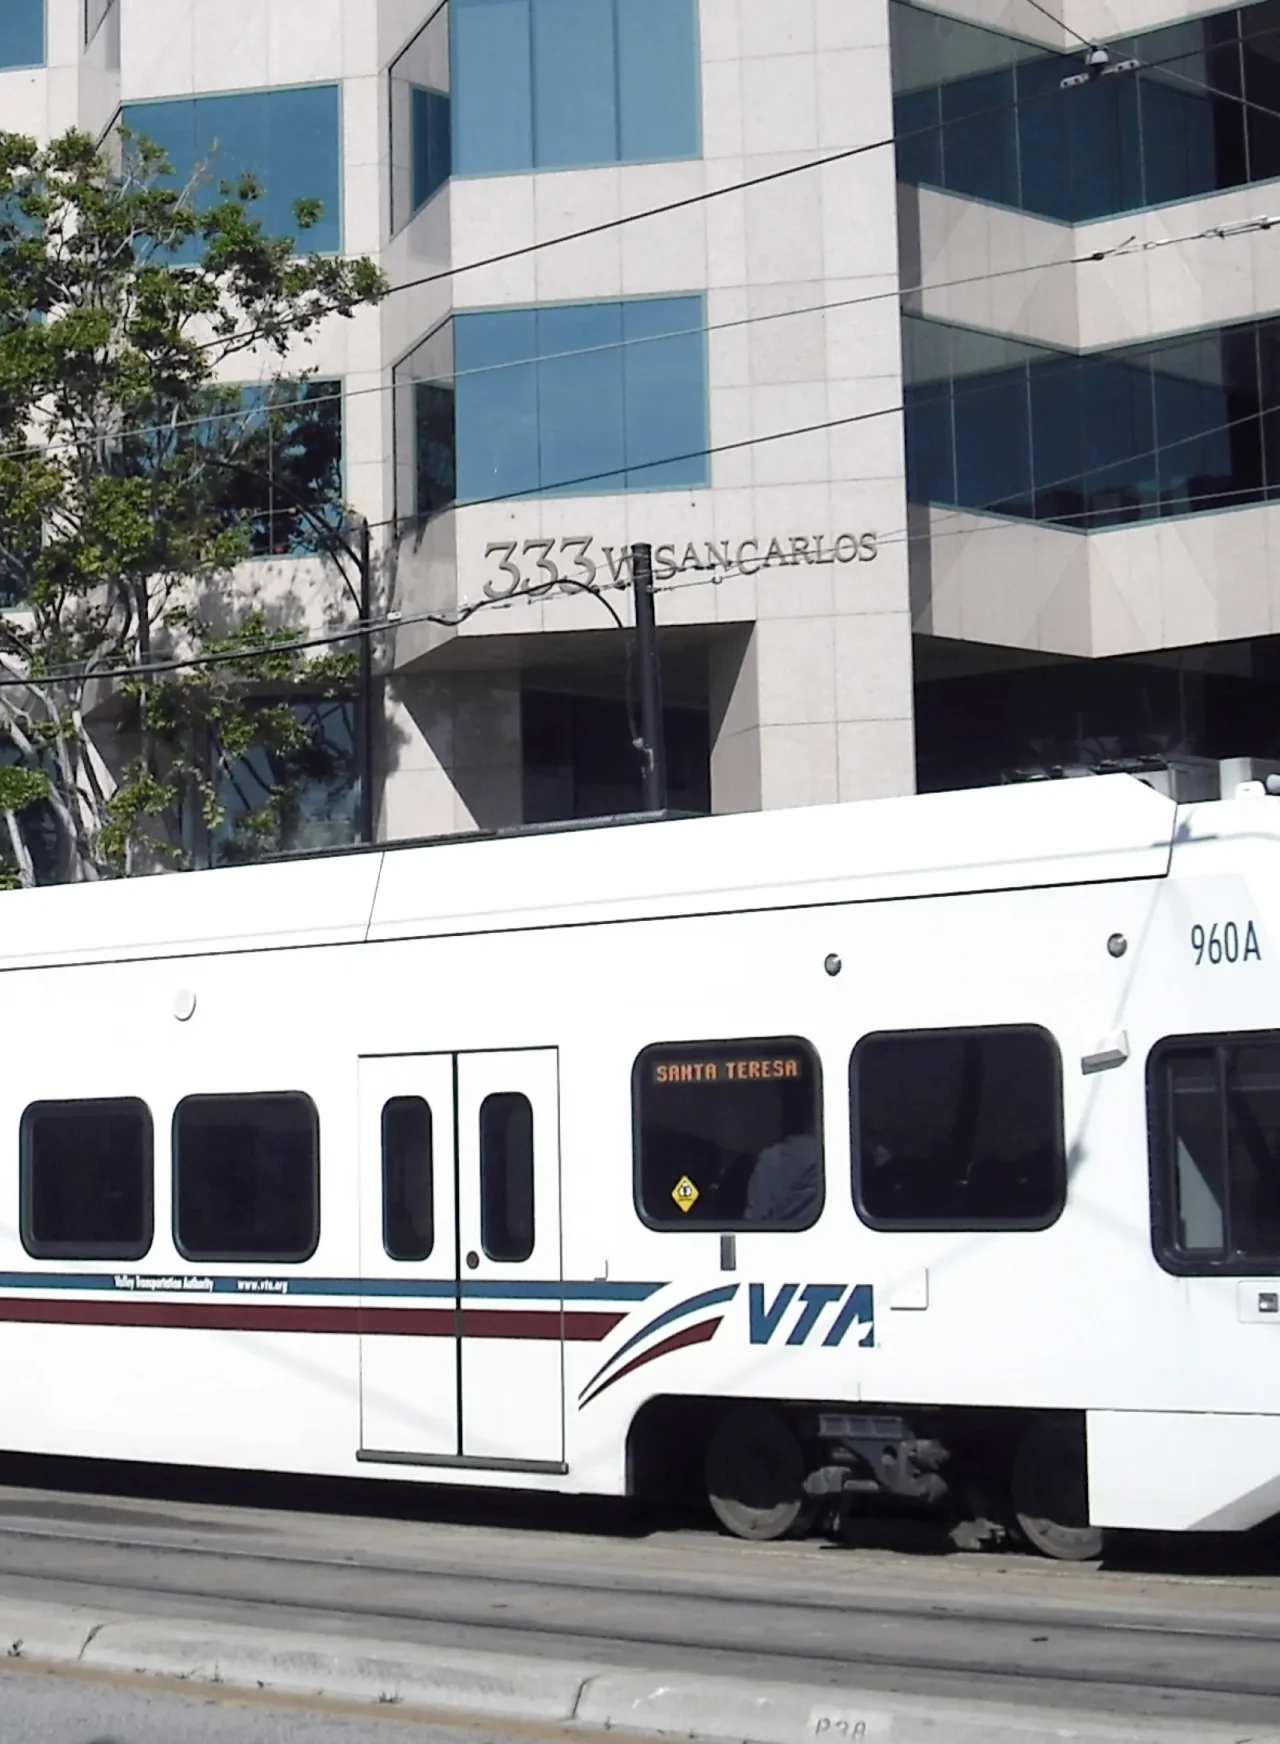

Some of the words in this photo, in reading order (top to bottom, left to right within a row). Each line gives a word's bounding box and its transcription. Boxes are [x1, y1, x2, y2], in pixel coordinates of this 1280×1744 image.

[482, 535, 597, 600] 333
[1190, 919, 1262, 967] 960A
[656, 1062, 717, 1083] SANTA
[726, 1059, 799, 1080] TERESA
[748, 1282, 876, 1348] VTA
